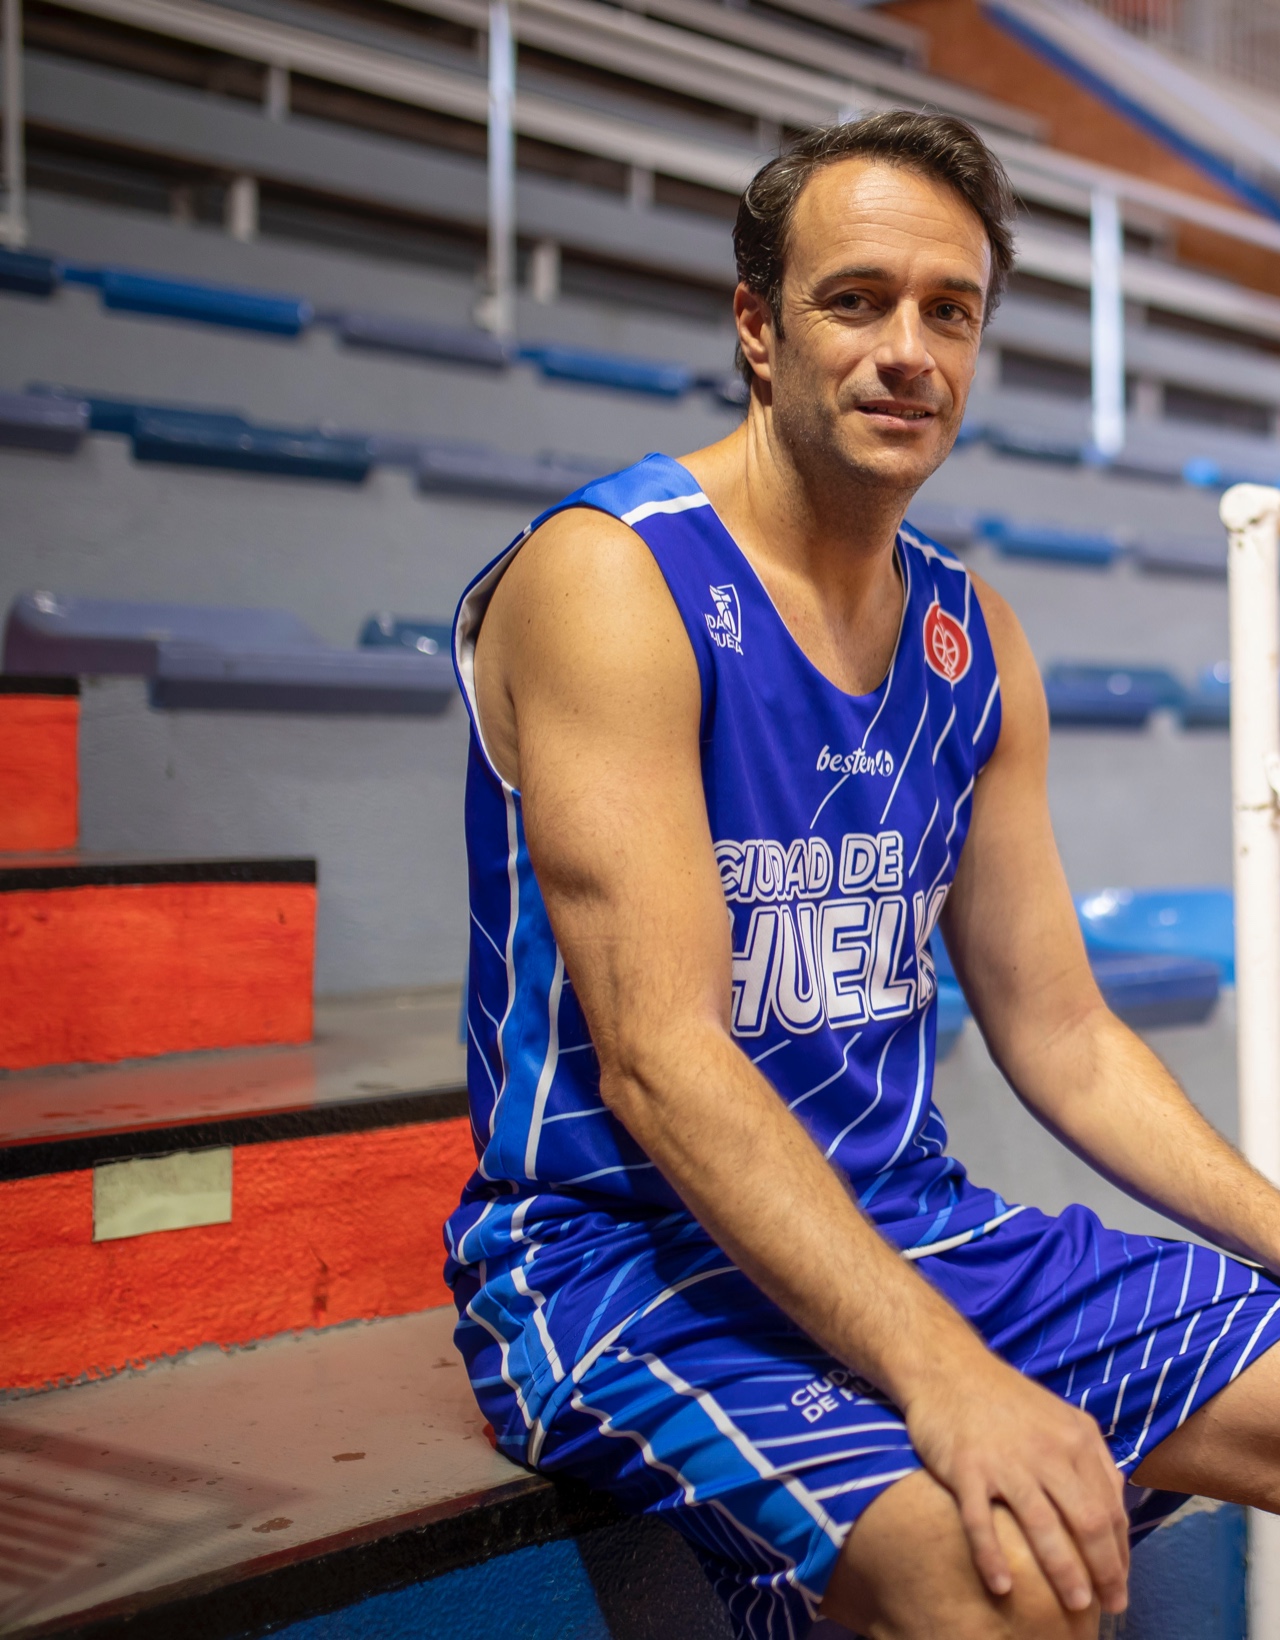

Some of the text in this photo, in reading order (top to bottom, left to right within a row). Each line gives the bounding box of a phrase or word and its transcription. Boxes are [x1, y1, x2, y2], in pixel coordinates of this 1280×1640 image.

[713, 831, 903, 903] CIUDAD DE
[791, 1369, 856, 1407] CIUD
[801, 1394, 839, 1423] DE
